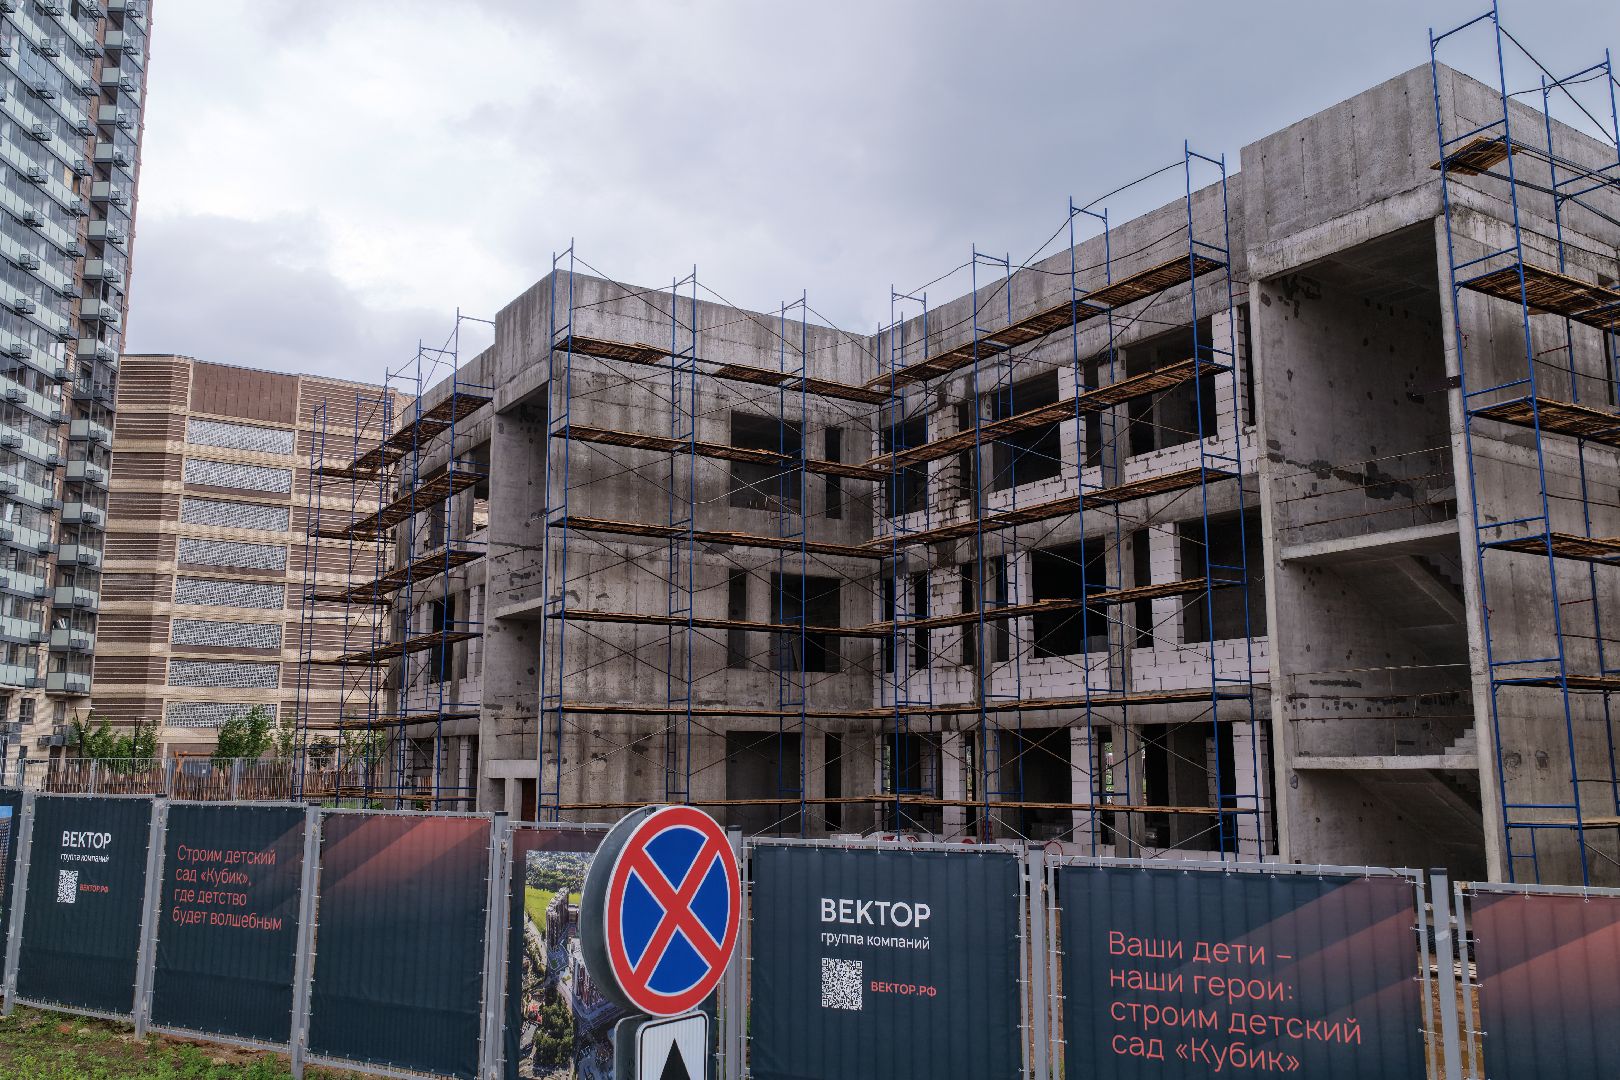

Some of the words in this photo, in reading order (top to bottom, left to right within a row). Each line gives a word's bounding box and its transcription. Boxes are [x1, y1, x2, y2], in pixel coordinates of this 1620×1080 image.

[62, 830, 112, 849] ВЕКТОР
[178, 844, 222, 865] Строим
[224, 849, 276, 865] детский
[176, 868, 197, 883] сад
[201, 867, 252, 887] «Кубик»,
[174, 888, 195, 903] где
[198, 890, 247, 906] детство
[172, 906, 208, 927] будет
[210, 912, 282, 931] волшебным
[820, 898, 931, 928] ВЕКТОР
[821, 932, 864, 947] группа
[867, 935, 930, 950] компаний
[1109, 931, 1183, 959] Ваши
[1192, 941, 1266, 966] дети
[871, 981, 937, 997] ВЕКТОР.РФ
[1110, 968, 1184, 992] наши
[1193, 975, 1294, 1004] герои:
[1110, 1001, 1218, 1031] строим
[1228, 1012, 1362, 1045] детский
[1112, 1034, 1164, 1061] сад
[1176, 1037, 1300, 1073] «Кубик»
